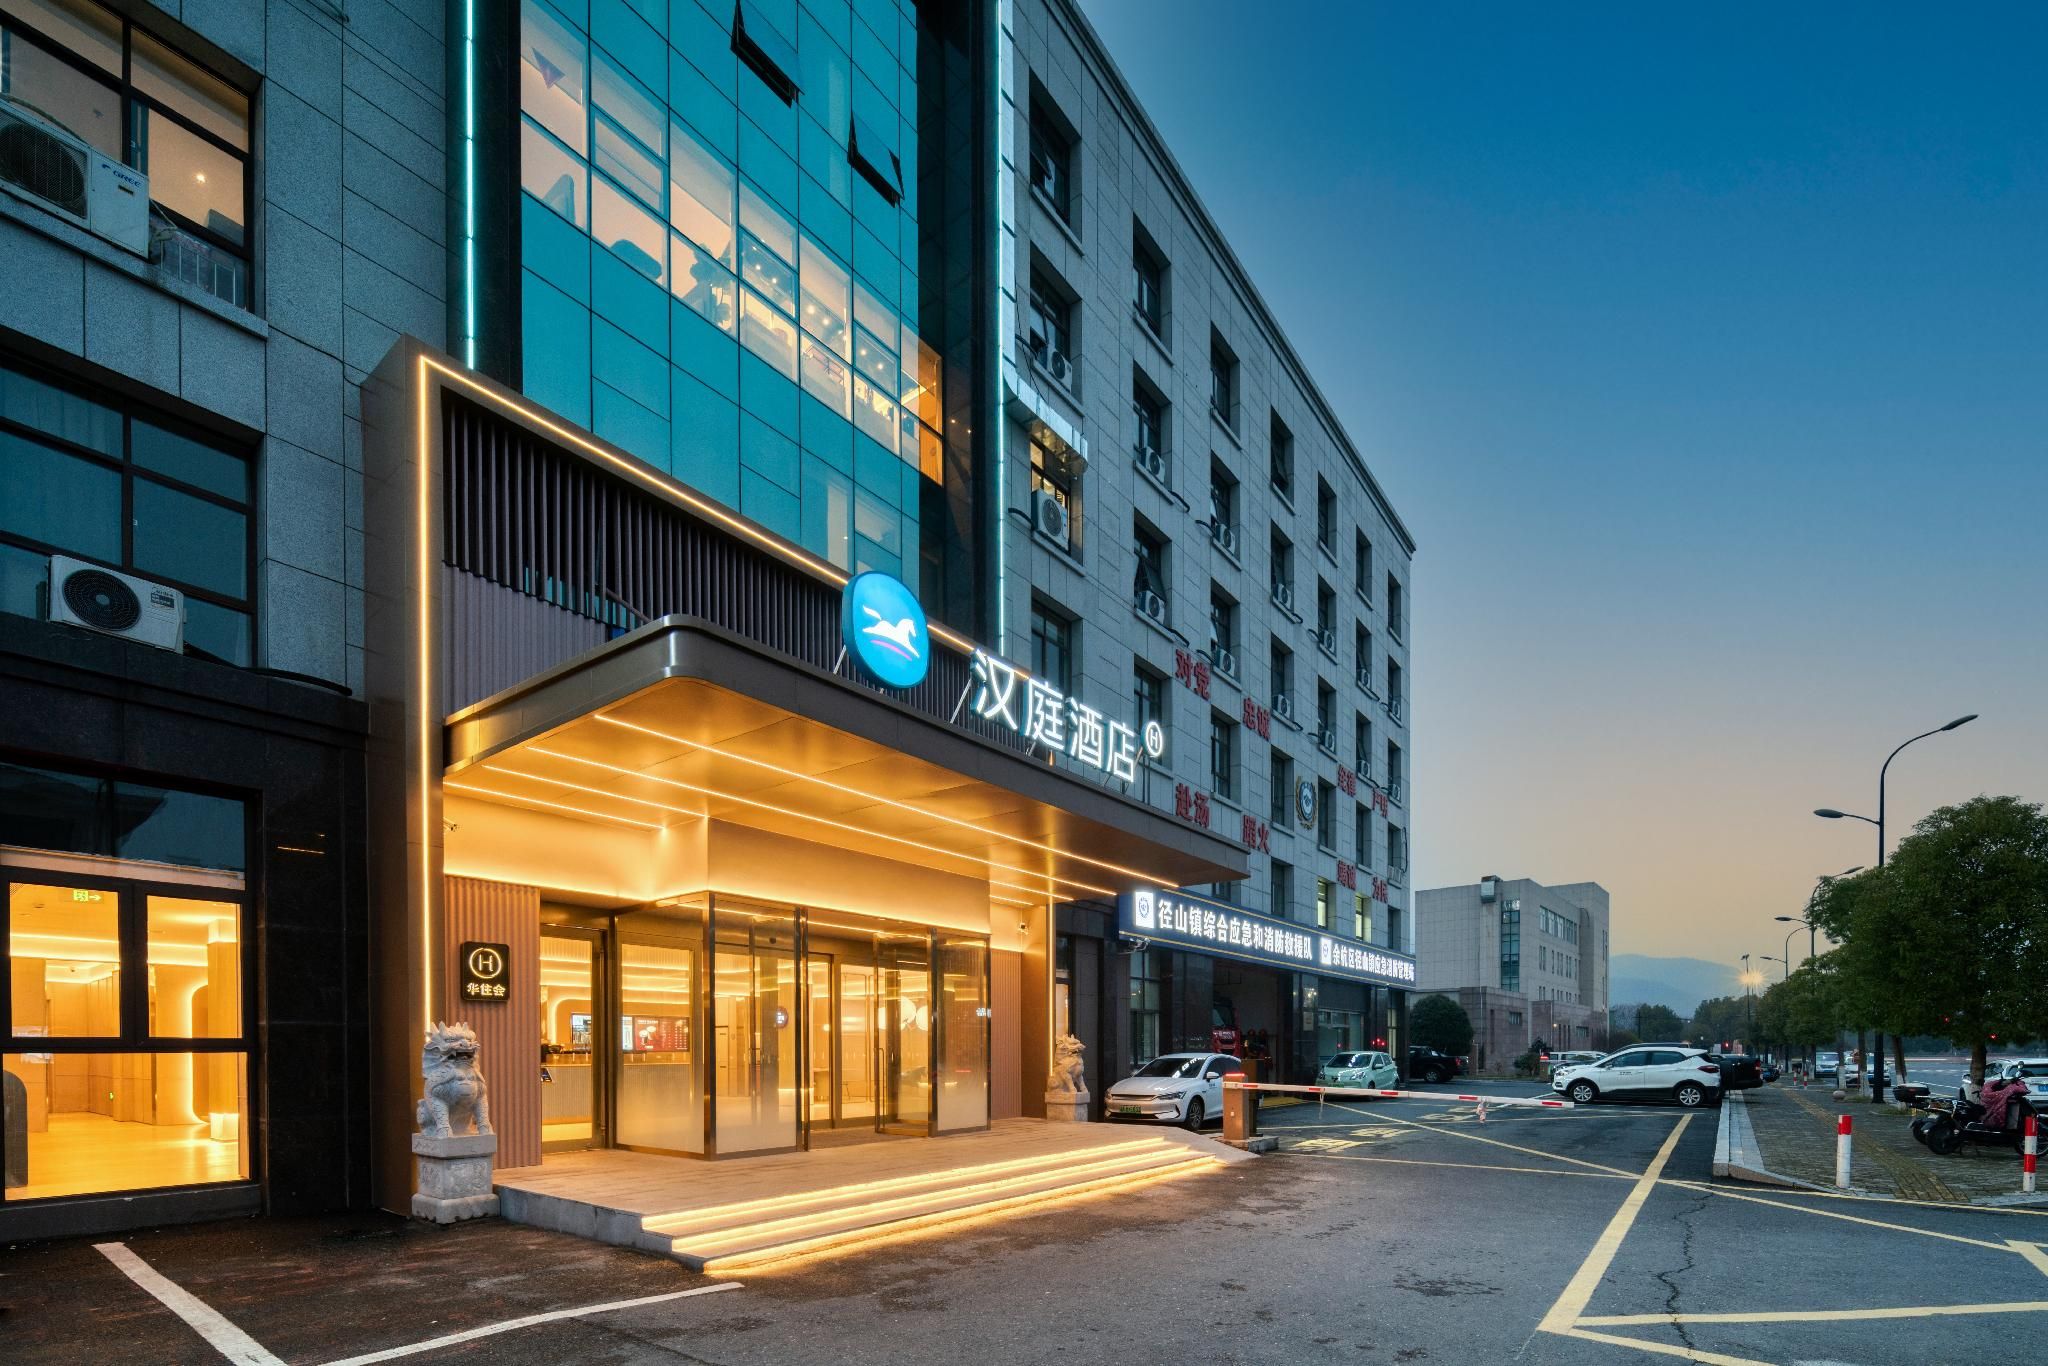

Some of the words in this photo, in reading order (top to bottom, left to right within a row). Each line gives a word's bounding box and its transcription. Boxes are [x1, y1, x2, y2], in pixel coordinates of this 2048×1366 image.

[113, 170, 141, 187] GREE
[970, 649, 1136, 784] 汉庭酒店
[1175, 648, 1211, 702] 对党
[1242, 696, 1271, 742] 忠诚
[1175, 782, 1210, 829] 赴汤
[1158, 898, 1313, 961] 径山镇综合应急和消防救援队
[467, 982, 506, 997] 华住会
